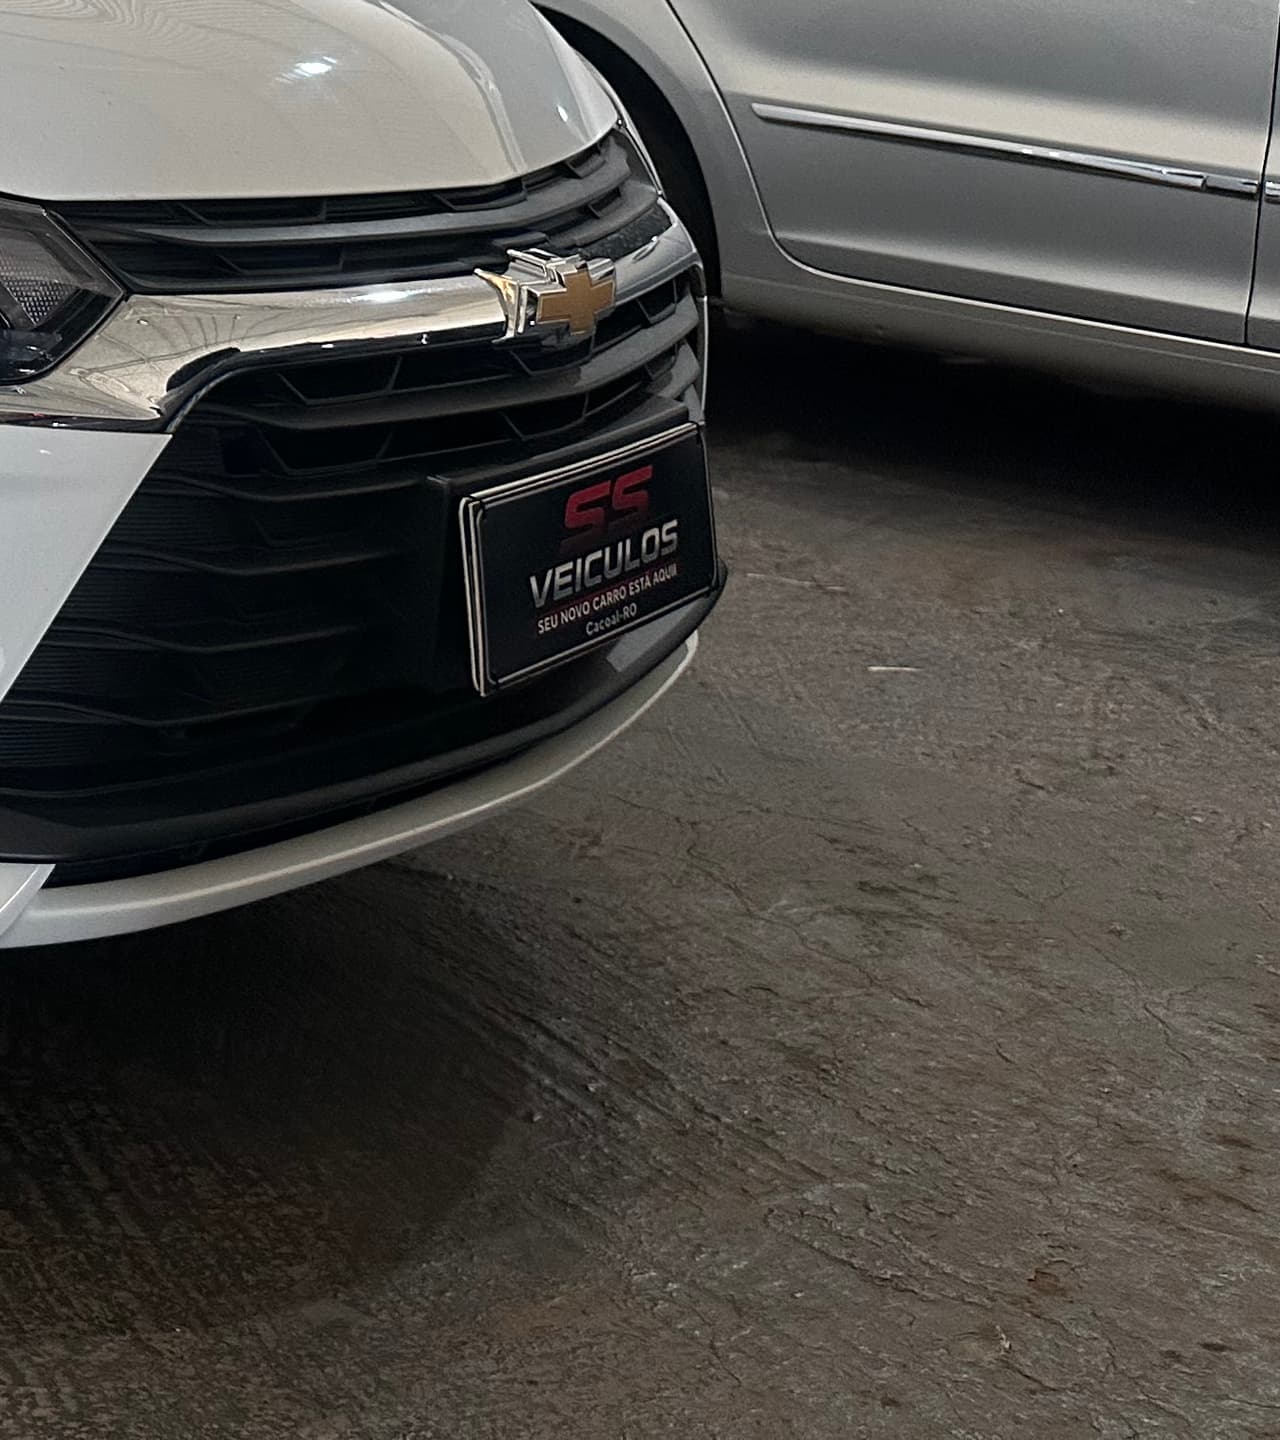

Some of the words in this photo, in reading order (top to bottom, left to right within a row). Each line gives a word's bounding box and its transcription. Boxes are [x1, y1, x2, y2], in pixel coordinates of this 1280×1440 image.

[560, 465, 653, 553] SS
[529, 519, 678, 608] VEICULOS
[537, 615, 559, 635] SEU
[560, 602, 591, 624] NOVO
[592, 587, 627, 610] CARRO
[585, 602, 637, 636] Cacoal-RO
